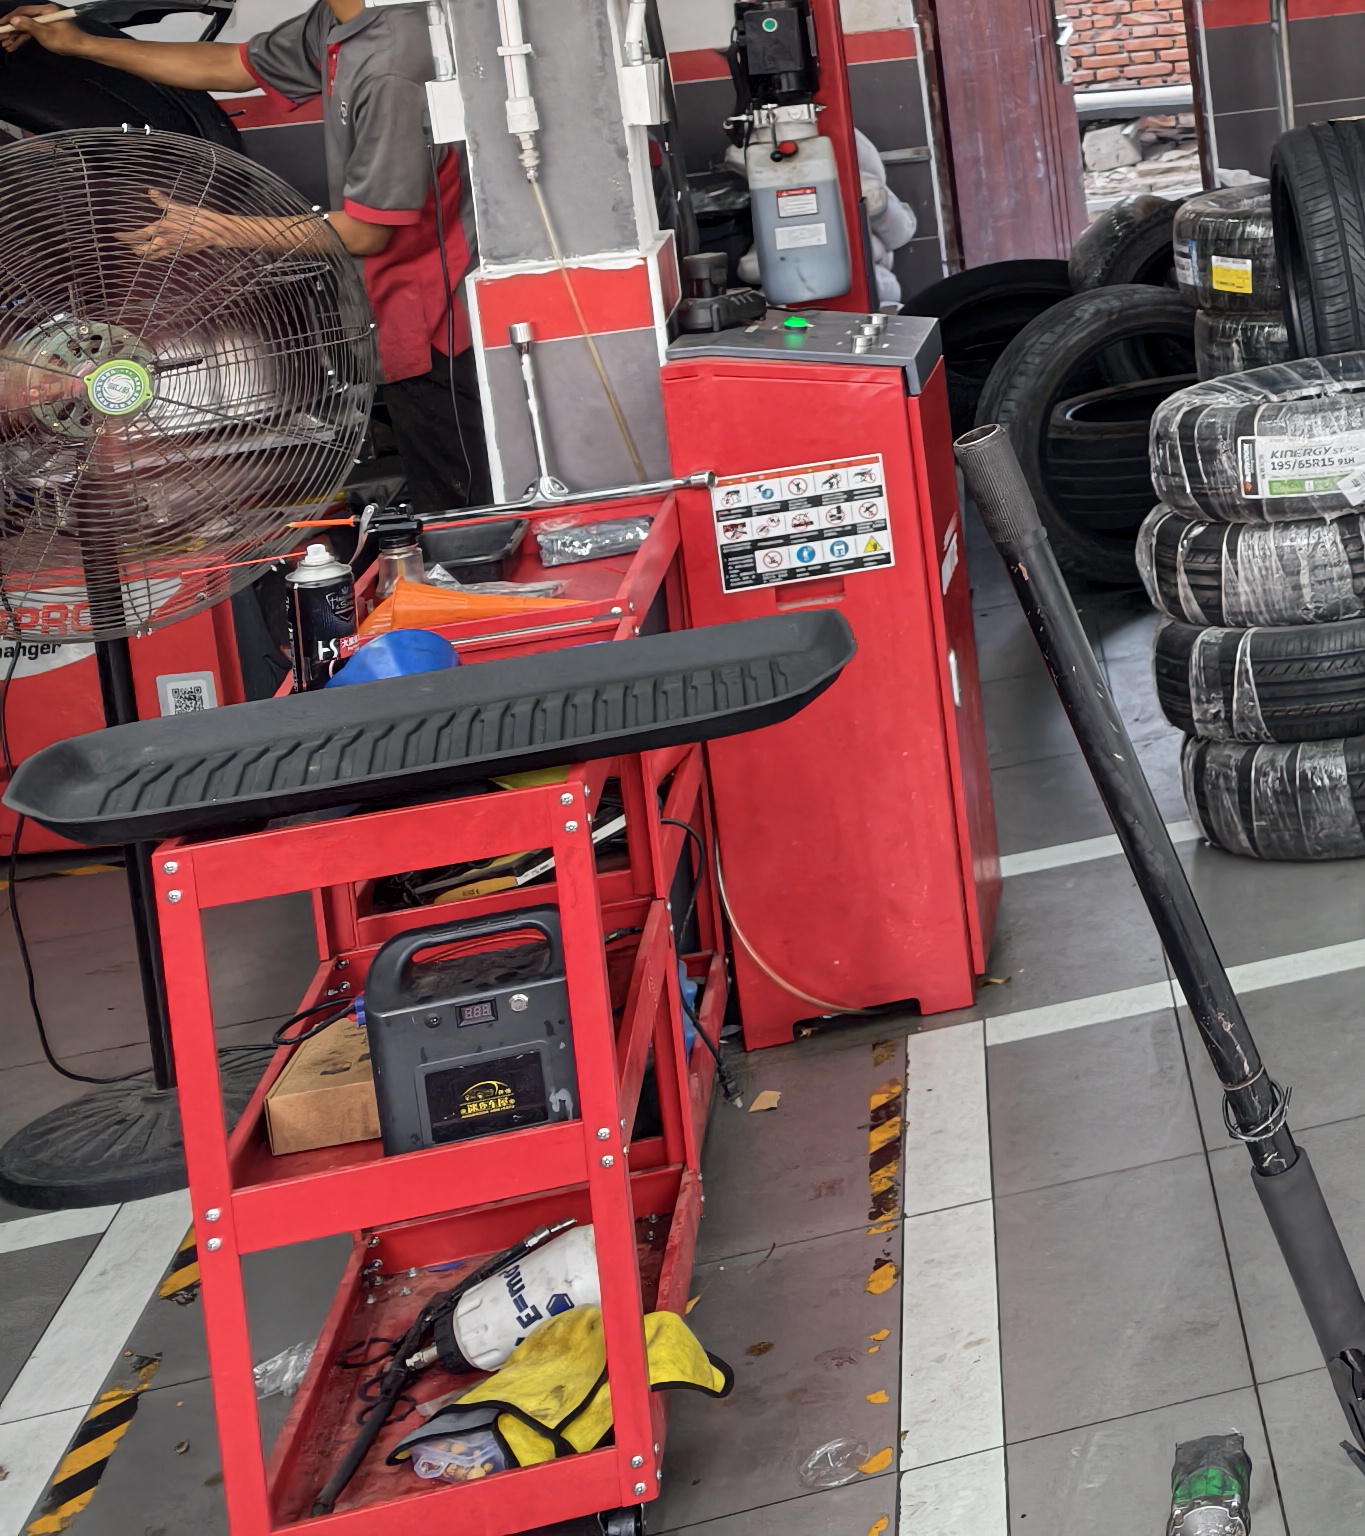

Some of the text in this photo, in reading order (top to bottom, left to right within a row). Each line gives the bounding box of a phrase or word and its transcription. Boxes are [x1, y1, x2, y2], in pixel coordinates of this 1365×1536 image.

[1270, 445, 1332, 459] KINERGY
[1270, 457, 1335, 471] 195/65R15
[0, 644, 61, 660] anger
